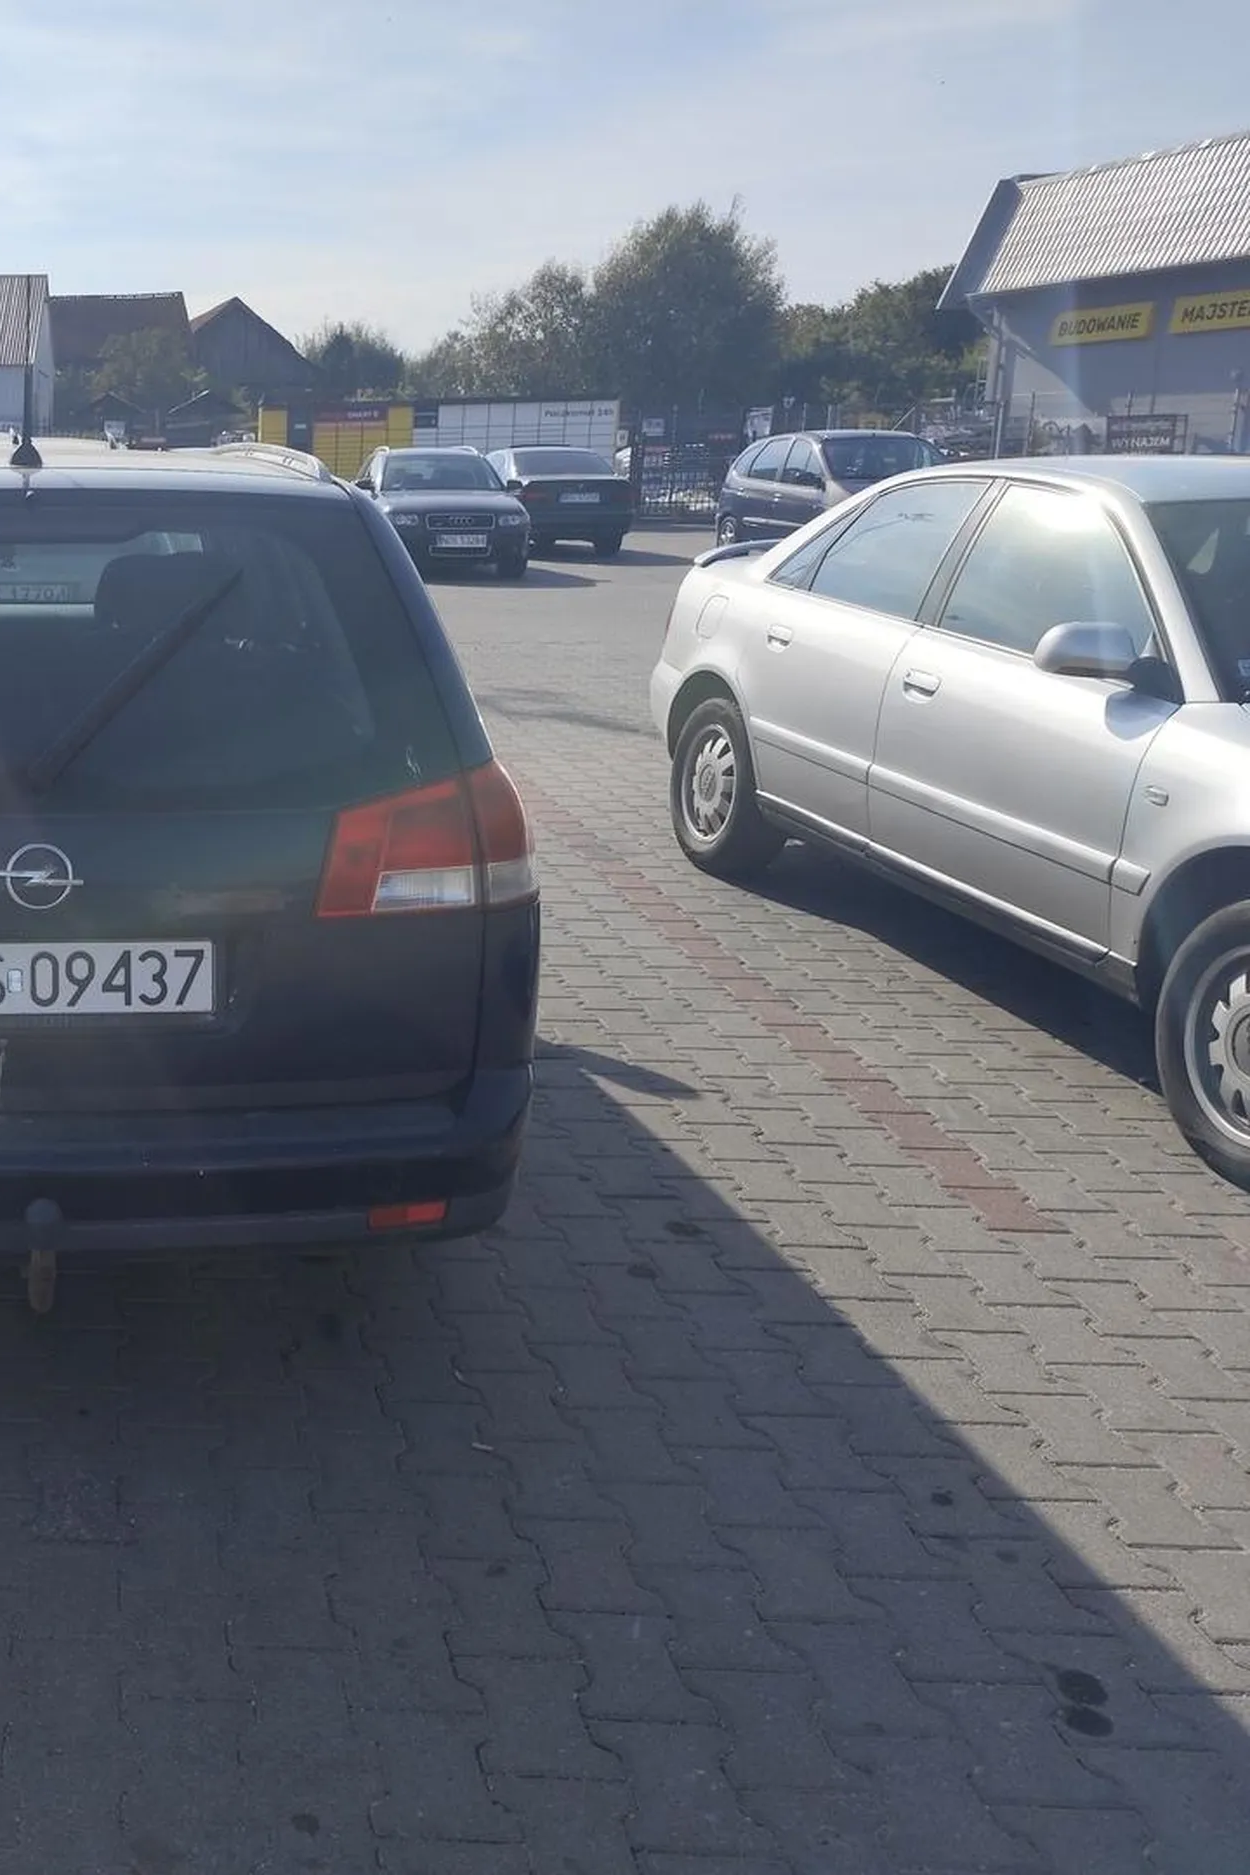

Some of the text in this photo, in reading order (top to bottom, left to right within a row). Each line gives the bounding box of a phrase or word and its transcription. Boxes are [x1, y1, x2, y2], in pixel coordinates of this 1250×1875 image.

[1180, 300, 1250, 323] MAJSTE
[1058, 312, 1142, 337] BUDOWANIE
[1112, 436, 1170, 449] WYNAJEM
[29, 950, 205, 1008] 09437
